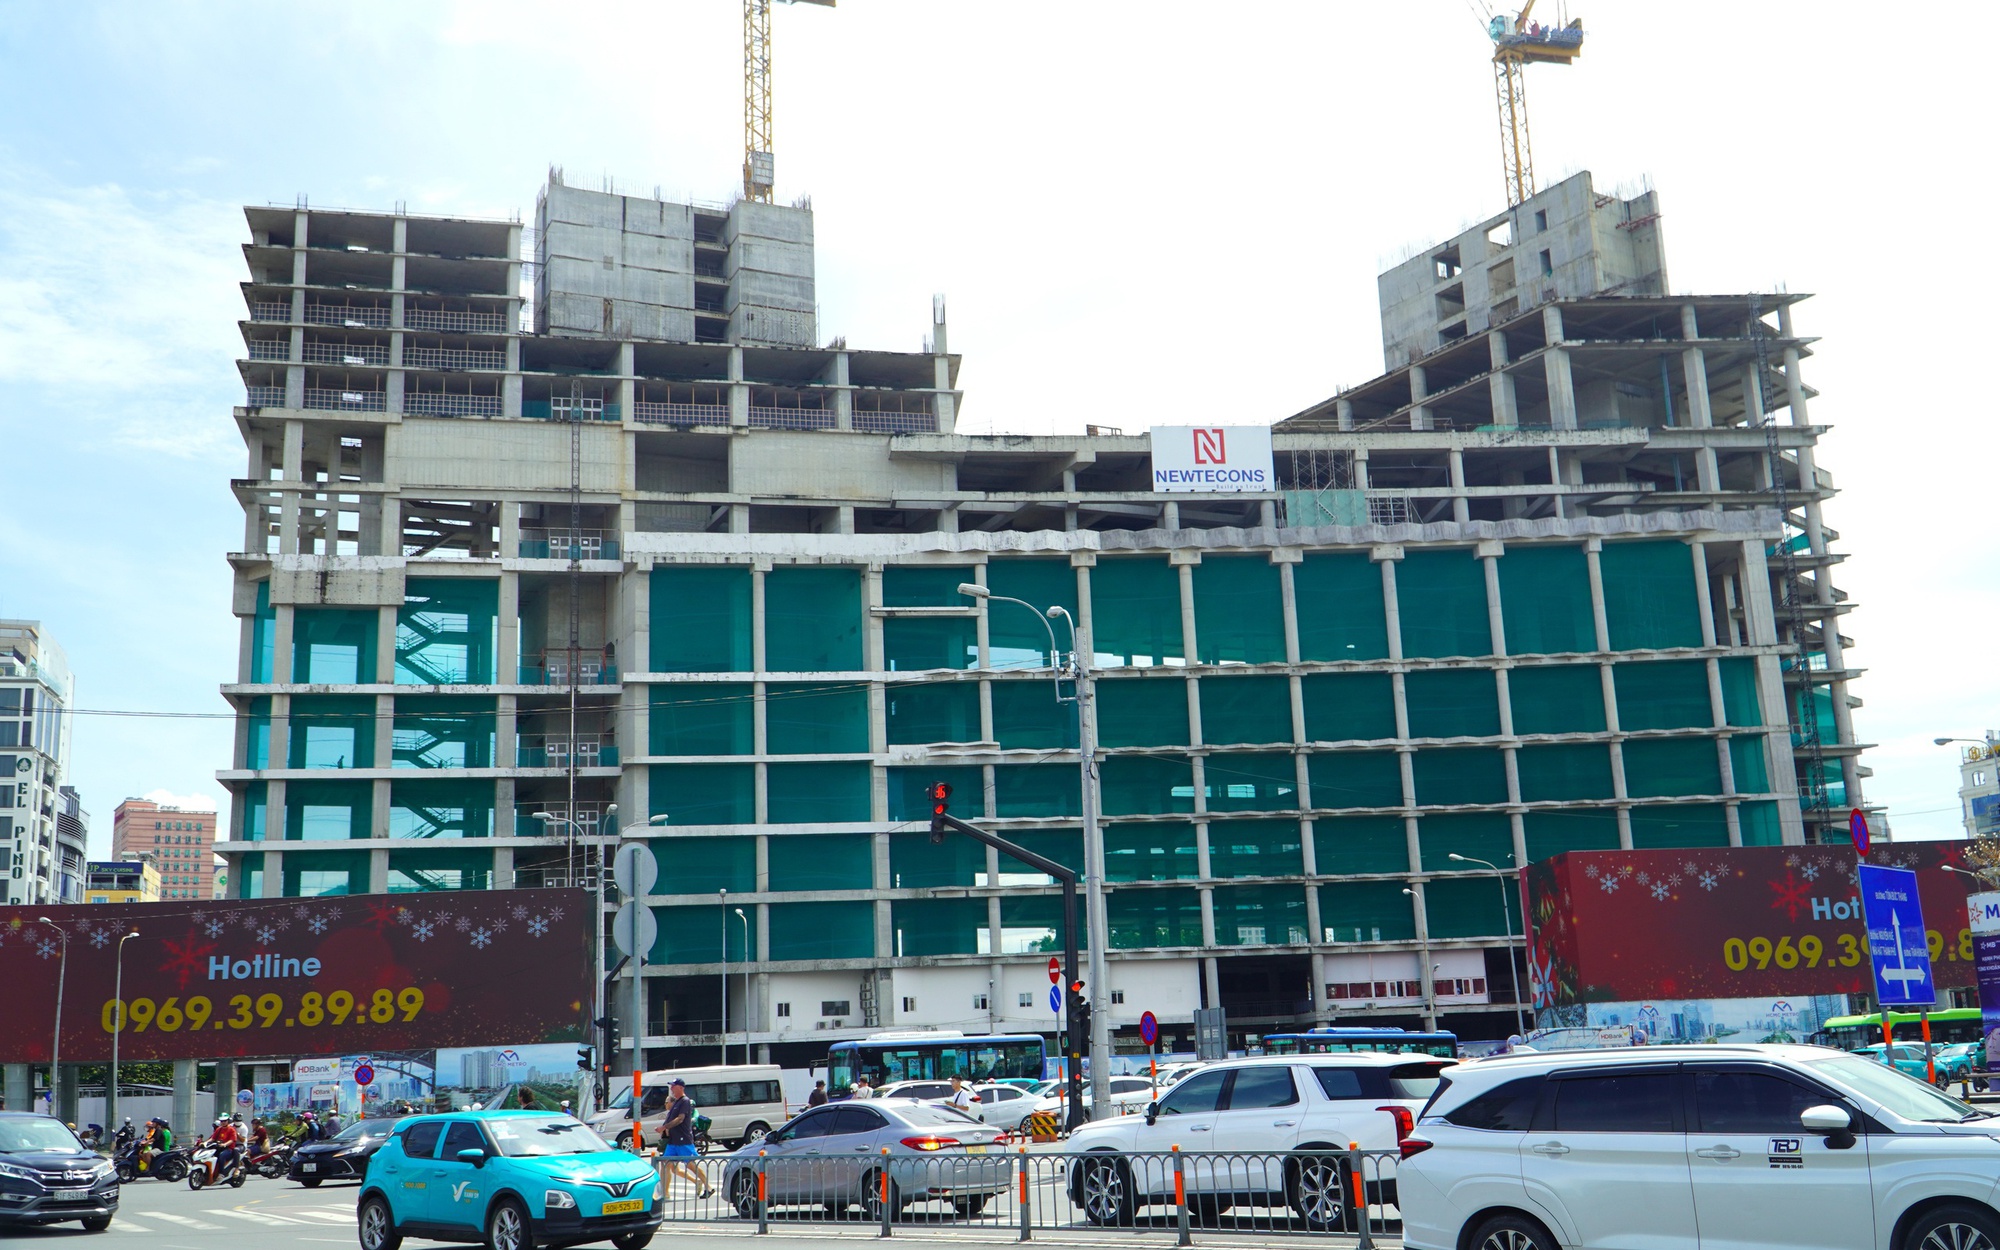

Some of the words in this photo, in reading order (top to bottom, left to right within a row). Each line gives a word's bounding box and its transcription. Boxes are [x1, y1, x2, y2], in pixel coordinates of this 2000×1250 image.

[1156, 470, 1265, 482] NEWTECONS
[17, 782, 28, 808] EL
[12, 826, 25, 880] PINO
[208, 954, 321, 980] Hotline
[101, 987, 424, 1033] 0969.39.89.89
[298, 1064, 329, 1073] HDBank
